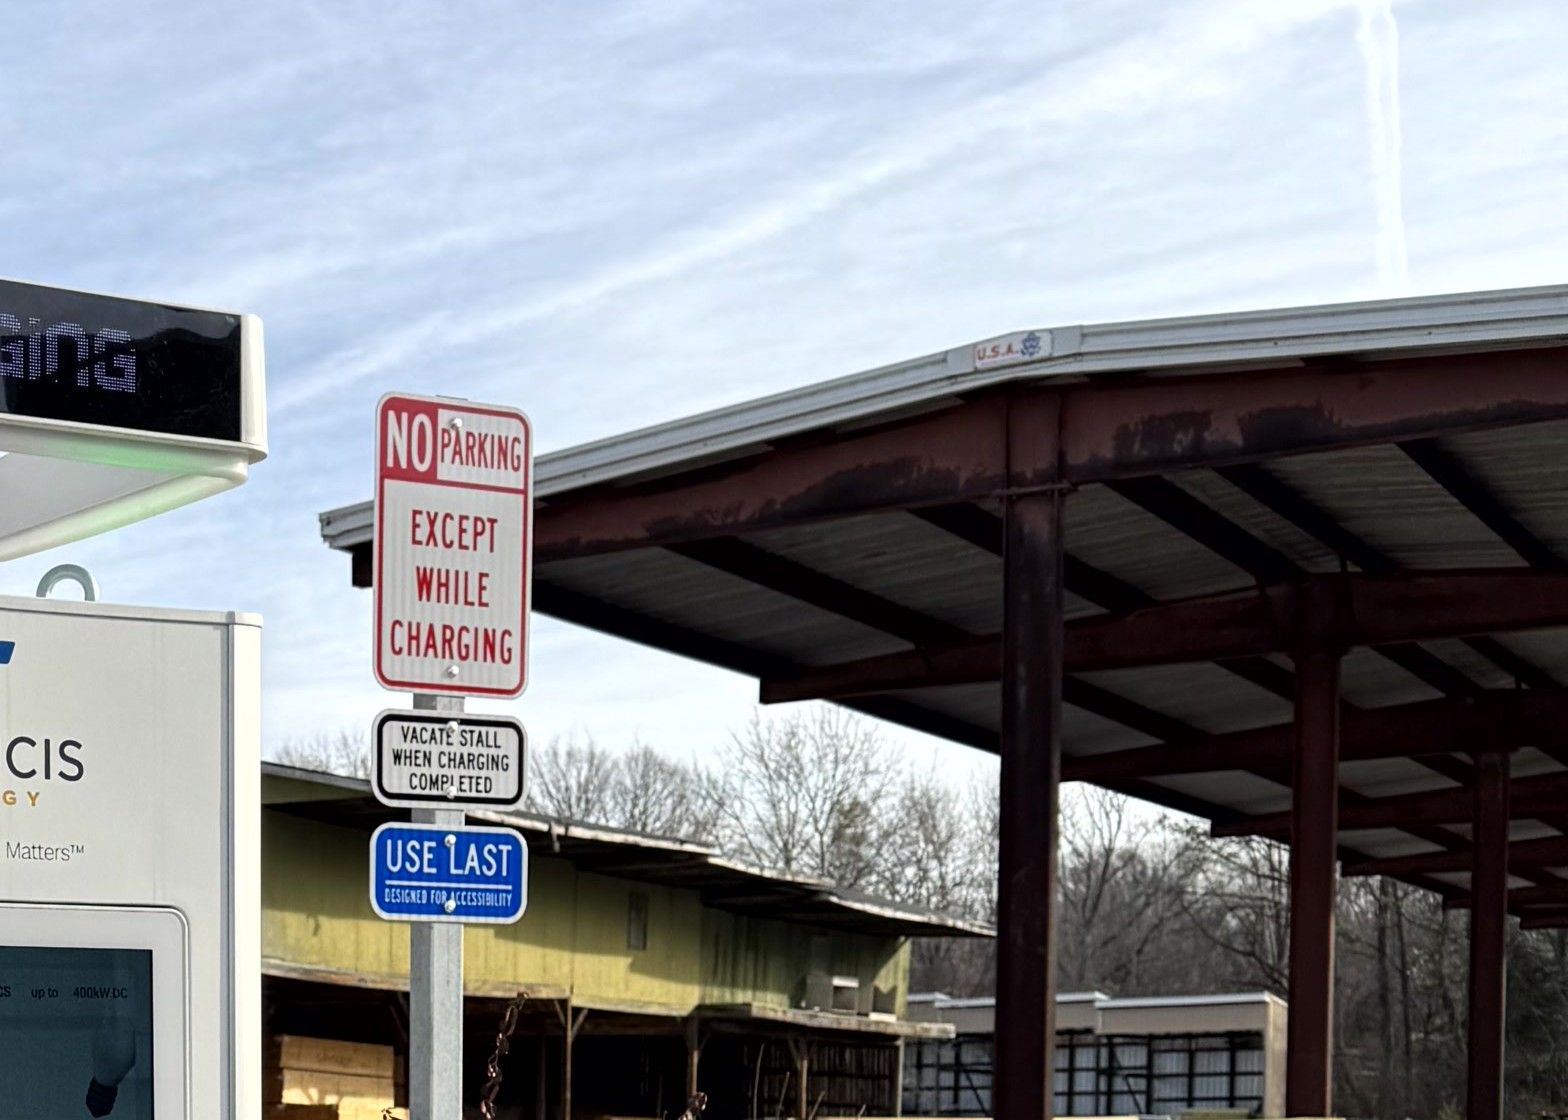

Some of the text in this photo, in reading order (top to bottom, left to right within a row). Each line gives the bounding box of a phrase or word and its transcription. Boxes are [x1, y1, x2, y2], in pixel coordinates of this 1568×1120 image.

[386, 410, 521, 472] NO PARKING
[411, 509, 498, 553] EXCEPT
[416, 566, 490, 608] WHILE
[390, 620, 512, 665] CHARGING
[401, 725, 502, 749] VACATE STALL
[392, 748, 510, 772] WHEN CHARGING
[386, 839, 512, 877] USE LAST
[385, 888, 513, 908] DESIGNED FOR ACCESSIBILITY
[31, 986, 128, 999] up to 400kW DC
